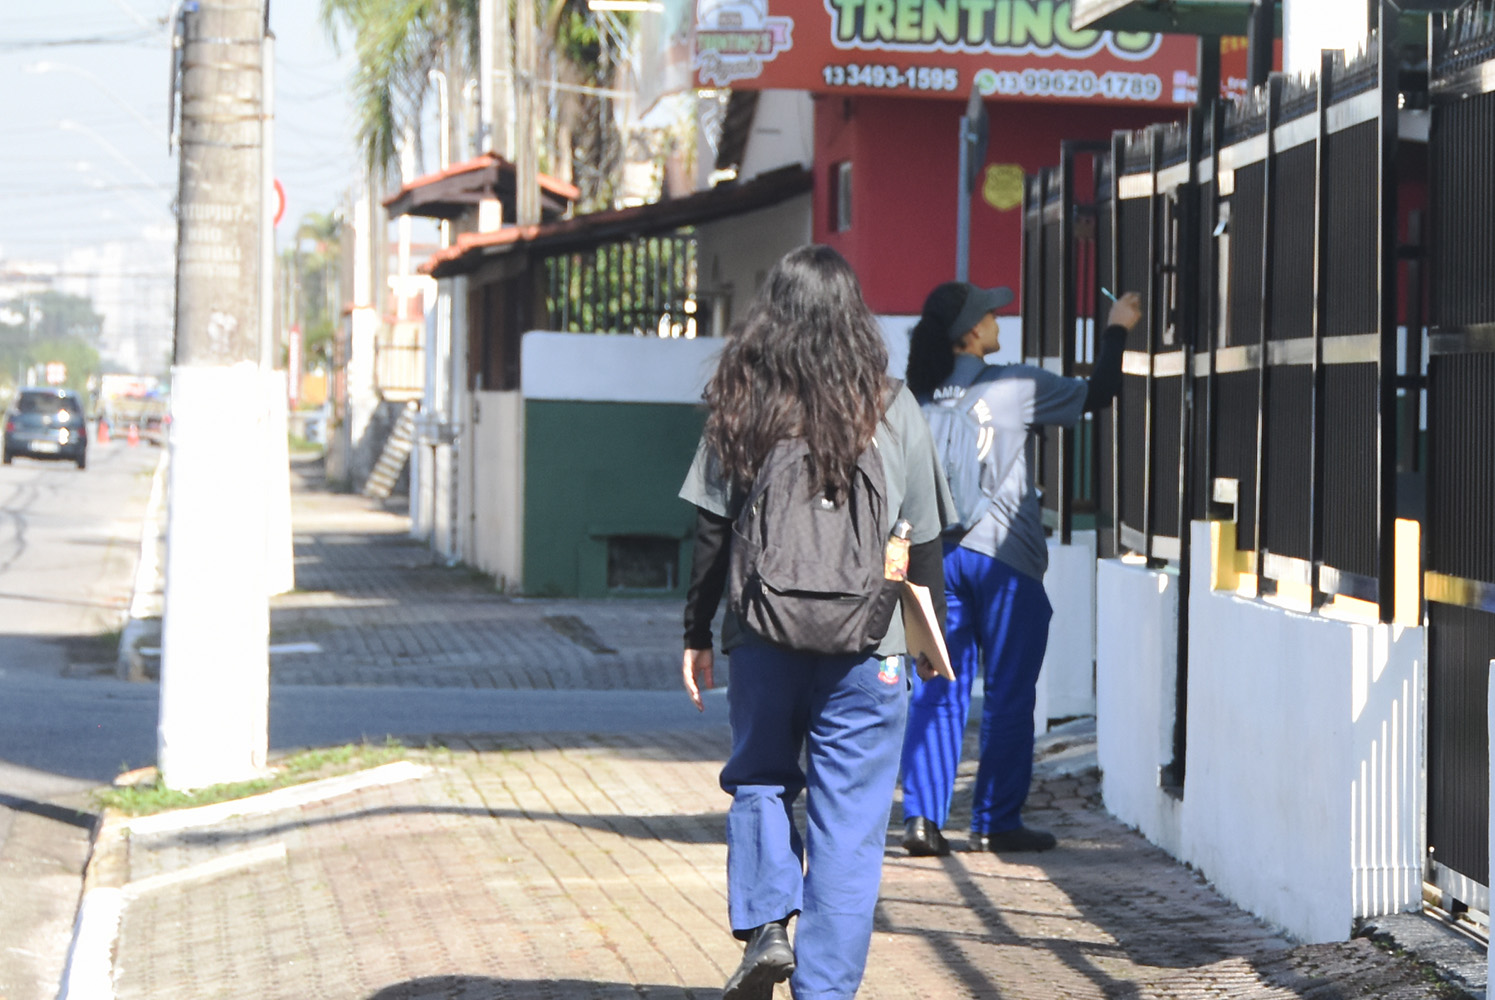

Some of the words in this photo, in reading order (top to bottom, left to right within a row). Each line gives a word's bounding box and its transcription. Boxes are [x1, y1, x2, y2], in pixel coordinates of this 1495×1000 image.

[823, 65, 845, 86] 13
[847, 63, 958, 91] 3493-1595
[999, 75, 1018, 90] 13
